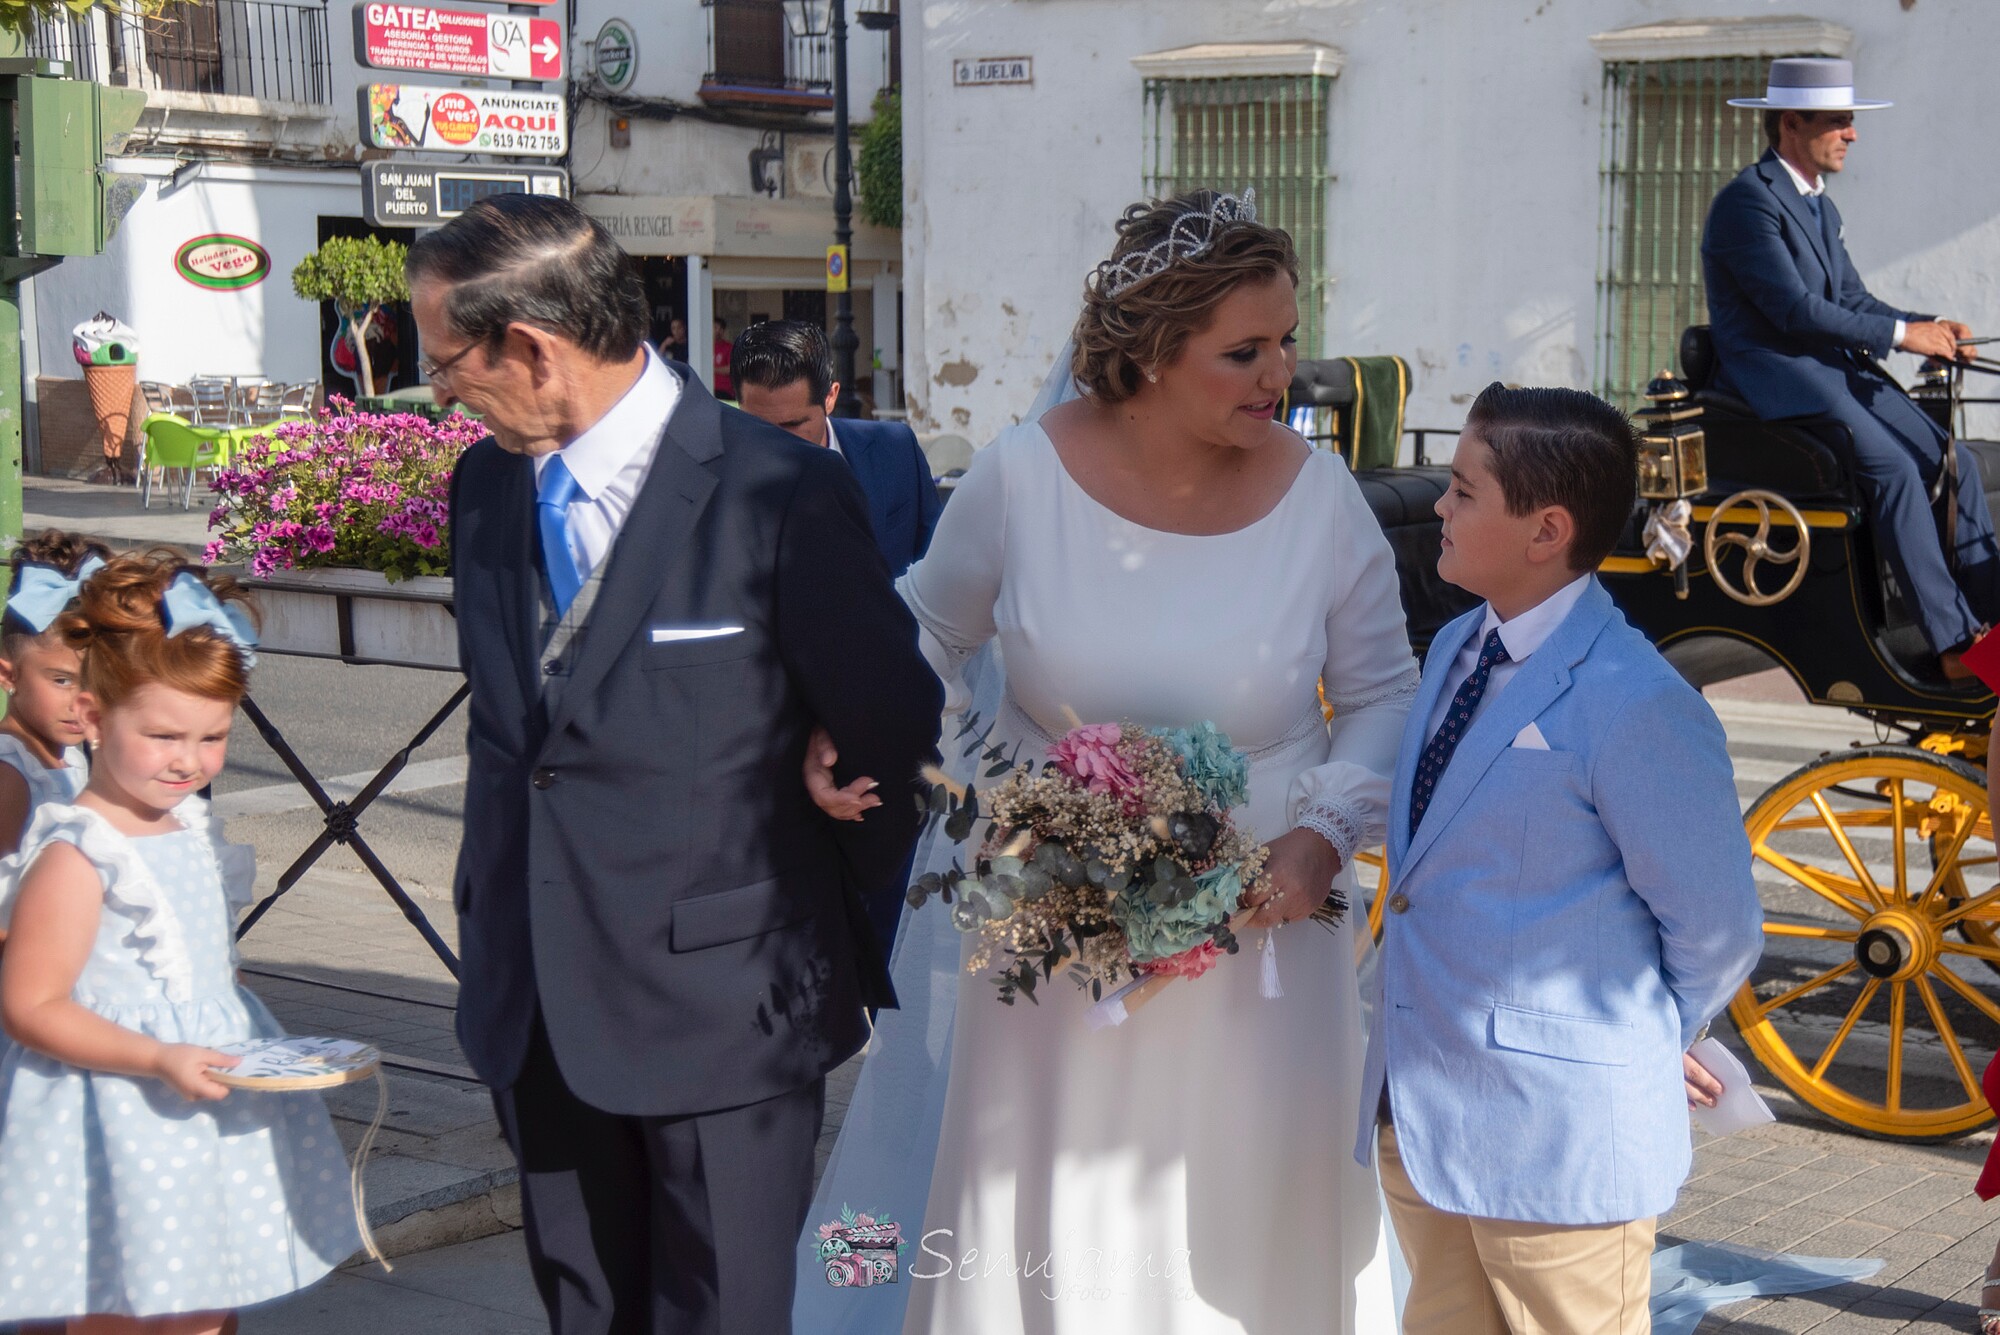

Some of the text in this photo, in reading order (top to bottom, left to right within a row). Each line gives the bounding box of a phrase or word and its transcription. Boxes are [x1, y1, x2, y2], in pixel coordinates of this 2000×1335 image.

[368, 4, 486, 31] GATEA SOLUCIONES
[384, 28, 473, 45] ASESORÍA GESTORÍA
[370, 46, 435, 60] TRANSFERENCIAS
[436, 52, 446, 60] DE
[388, 39, 470, 54] HERENCIAS SEGUROS
[974, 63, 1024, 80] HUELVA
[437, 97, 466, 112] ¿me
[481, 96, 559, 111] ANÚNCIATE
[447, 109, 477, 123] ves?
[483, 113, 556, 132] AQUÍ
[493, 133, 560, 150] 619 472 758
[380, 173, 432, 187] SAN JUAN
[395, 188, 416, 200] DEL
[385, 202, 428, 215] PUERTO
[634, 215, 674, 237] RENGEL
[209, 254, 254, 272] Vega
